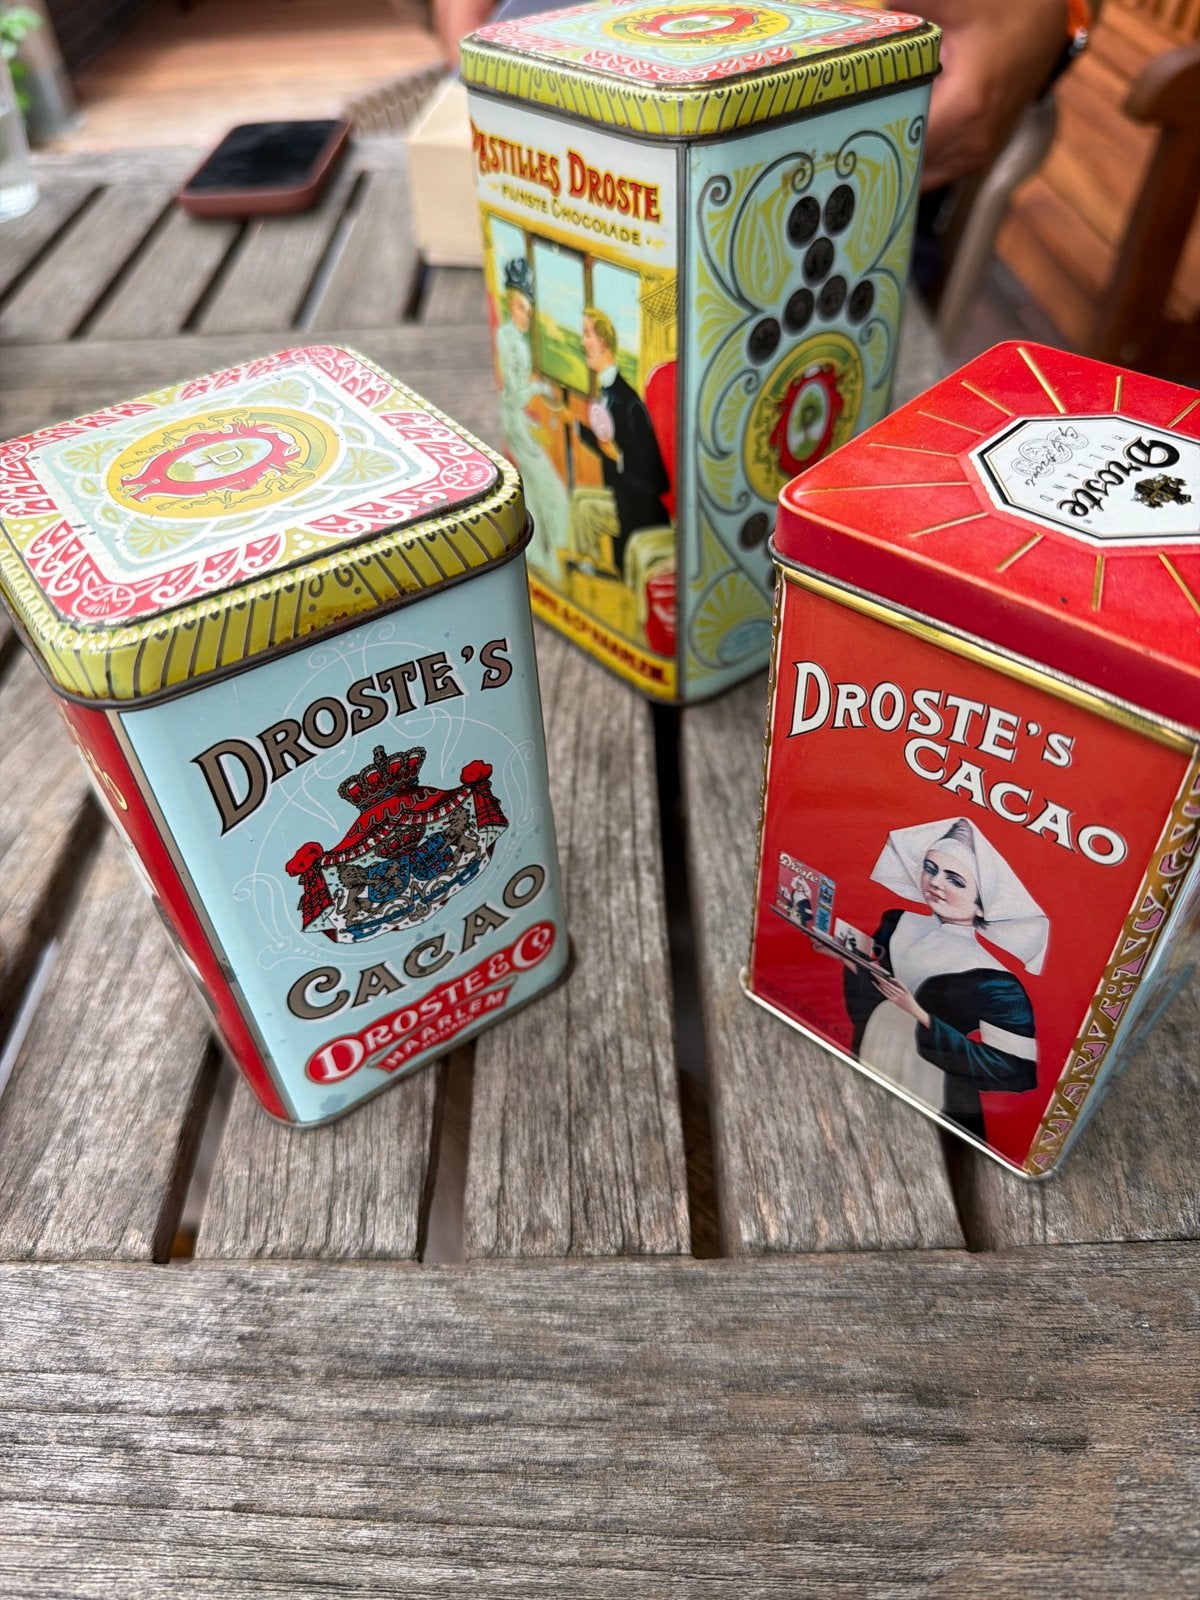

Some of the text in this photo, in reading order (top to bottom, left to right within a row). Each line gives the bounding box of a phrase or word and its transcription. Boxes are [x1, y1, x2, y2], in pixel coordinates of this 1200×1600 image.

[550, 199, 642, 246] CHOCOLADE
[567, 149, 661, 224] DROSTE
[1039, 434, 1127, 502] HOLLAND
[1057, 437, 1181, 517] Droste
[190, 639, 513, 836] DROSTE'S
[786, 660, 1075, 768] DROSTE'S
[903, 737, 1129, 867] CACAO
[780, 853, 818, 882] Droste
[286, 864, 547, 1021] CACAO
[319, 969, 486, 1080] DROSTE
[385, 990, 505, 1066] HAARLEM
